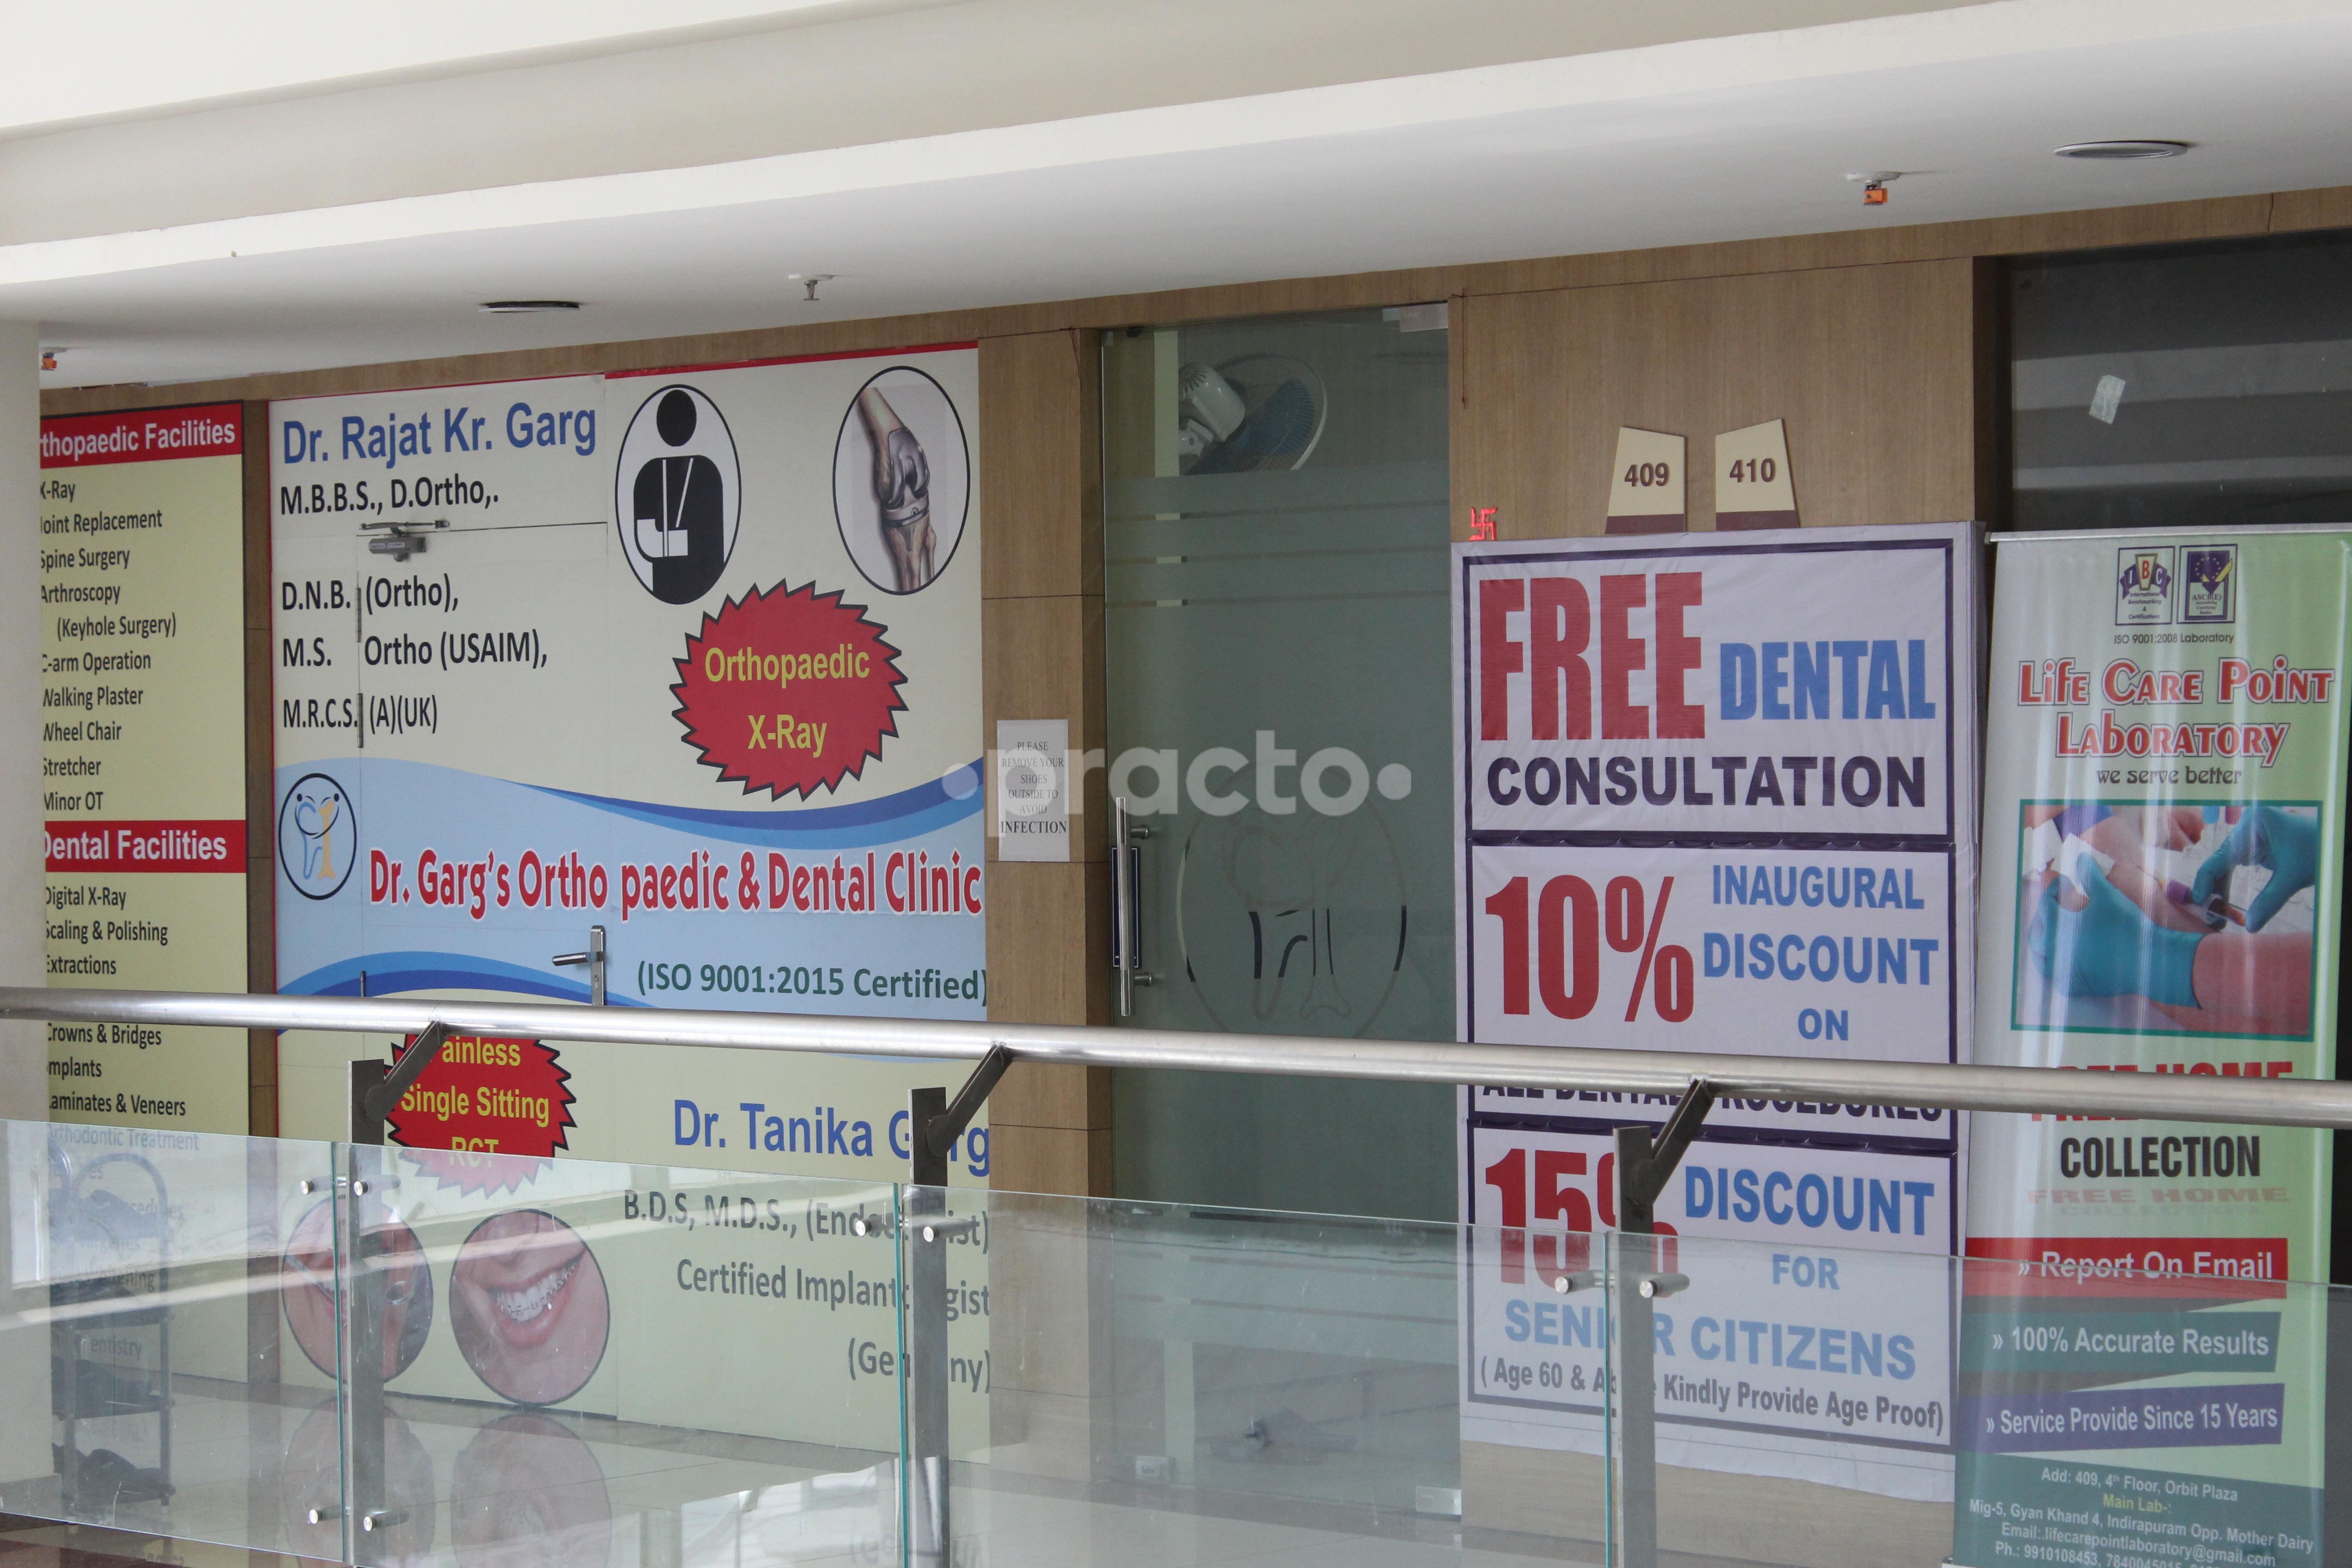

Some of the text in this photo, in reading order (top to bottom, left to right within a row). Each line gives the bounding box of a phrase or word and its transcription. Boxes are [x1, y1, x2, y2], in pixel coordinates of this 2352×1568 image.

[40, 419, 235, 461] thopaedic Facilities
[284, 402, 596, 469] Dr. Rajat Kr. Garg
[1624, 462, 1670, 487] 409
[1729, 458, 1776, 484] 410
[281, 481, 382, 515] M.B.B.S.,
[74, 510, 162, 536] Replacement
[78, 548, 130, 570] Surgery
[41, 583, 120, 604] Arthroscopy
[282, 573, 458, 614] D.N.B. (Ortho),
[57, 612, 176, 641] (Keyhole Surgery)
[2114, 634, 2130, 644] ISO
[2180, 633, 2235, 644] Laboratory
[83, 651, 151, 675] Operation
[283, 629, 547, 671] M.S. Ortho (USAIM),
[705, 643, 870, 689] Orthopaedic
[1479, 571, 1936, 741] FREE DENTAL
[97, 686, 143, 706] Plaster
[283, 695, 437, 734] M.R.C.S. (A)(UK)
[87, 721, 122, 741] Chair
[748, 714, 827, 758] X-Ray
[1017, 741, 1049, 751] PLEASE
[1002, 758, 1064, 768] REMOVE YOUR
[1020, 774, 1047, 784] SHOES
[2097, 766, 2242, 784] we serve better
[1008, 789, 1058, 799] OUTSIDE TO
[1487, 756, 1926, 808] CONSULTATION
[44, 791, 103, 811] Minor OT
[1019, 804, 1047, 814] AVOID
[1000, 821, 1067, 834] INFECTION
[118, 829, 227, 860] Facilities
[46, 886, 126, 910] Digital X-Ray
[370, 849, 982, 921] Dr. Garg's Ortho paedic & Dental Clinic
[1712, 865, 1925, 910] INAUGURAL
[92, 920, 103, 940] &
[108, 921, 168, 946] Polishing
[1485, 874, 1694, 1023] 10%
[1703, 932, 1939, 985] DISCOUNT
[638, 960, 987, 1006] (ISO 9001:2015 Certified)
[97, 1023, 108, 1043] &
[112, 1024, 162, 1049] Bridges
[1798, 1008, 1848, 1041] ON
[442, 1036, 521, 1066] ainless
[49, 1056, 102, 1080] mplants
[49, 1091, 186, 1116] aminates & Veneers
[401, 1085, 549, 1127] Single Sitting
[127, 1128, 199, 1151] Treatment
[451, 1136, 499, 1168] RCT
[674, 1099, 990, 1177] Dr. Tanika Grg
[2060, 1135, 2261, 1179] COLLECTION
[1685, 1166, 1935, 1236] DISCOUNT
[2026, 1186, 2291, 1205] FREE HOME
[624, 1189, 695, 1231] B.D.S,
[705, 1195, 797, 1239] M.D.S.,
[1772, 1253, 1839, 1290] FOR
[2041, 1251, 2273, 1284] Report On Email
[677, 1259, 990, 1322] Certified Implantgist
[84, 1334, 142, 1361] entistry
[1504, 1299, 1916, 1381] SENIR CITIZENS
[2011, 1326, 2269, 1356] 100% Accurate Results
[848, 1338, 990, 1394] (Geny)
[1539, 1361, 1563, 1389] 60
[1570, 1364, 1586, 1391] &
[1664, 1374, 1731, 1413] Kindly
[1737, 1382, 1819, 1416] Provide
[1826, 1392, 1868, 1427] Age
[1876, 1395, 1944, 1436] Proof)
[2000, 1402, 2278, 1435] Service Provide Since 15 Years
[2042, 1467, 2071, 1483] Add:
[2075, 1470, 2101, 1489] 409,
[2124, 1475, 2161, 1494] Floor,
[2165, 1480, 2199, 1497] Orbit
[2203, 1484, 2238, 1501] Plaza
[2102, 1493, 2133, 1509] Main
[2011, 1503, 2043, 1521] Gyan
[2047, 1506, 2088, 1525] Khand
[2107, 1513, 2187, 1536] Indirapuram
[2190, 1523, 2222, 1541] Opp.
[2226, 1527, 2274, 1547] Mother
[2278, 1533, 2314, 1555] Dairy
